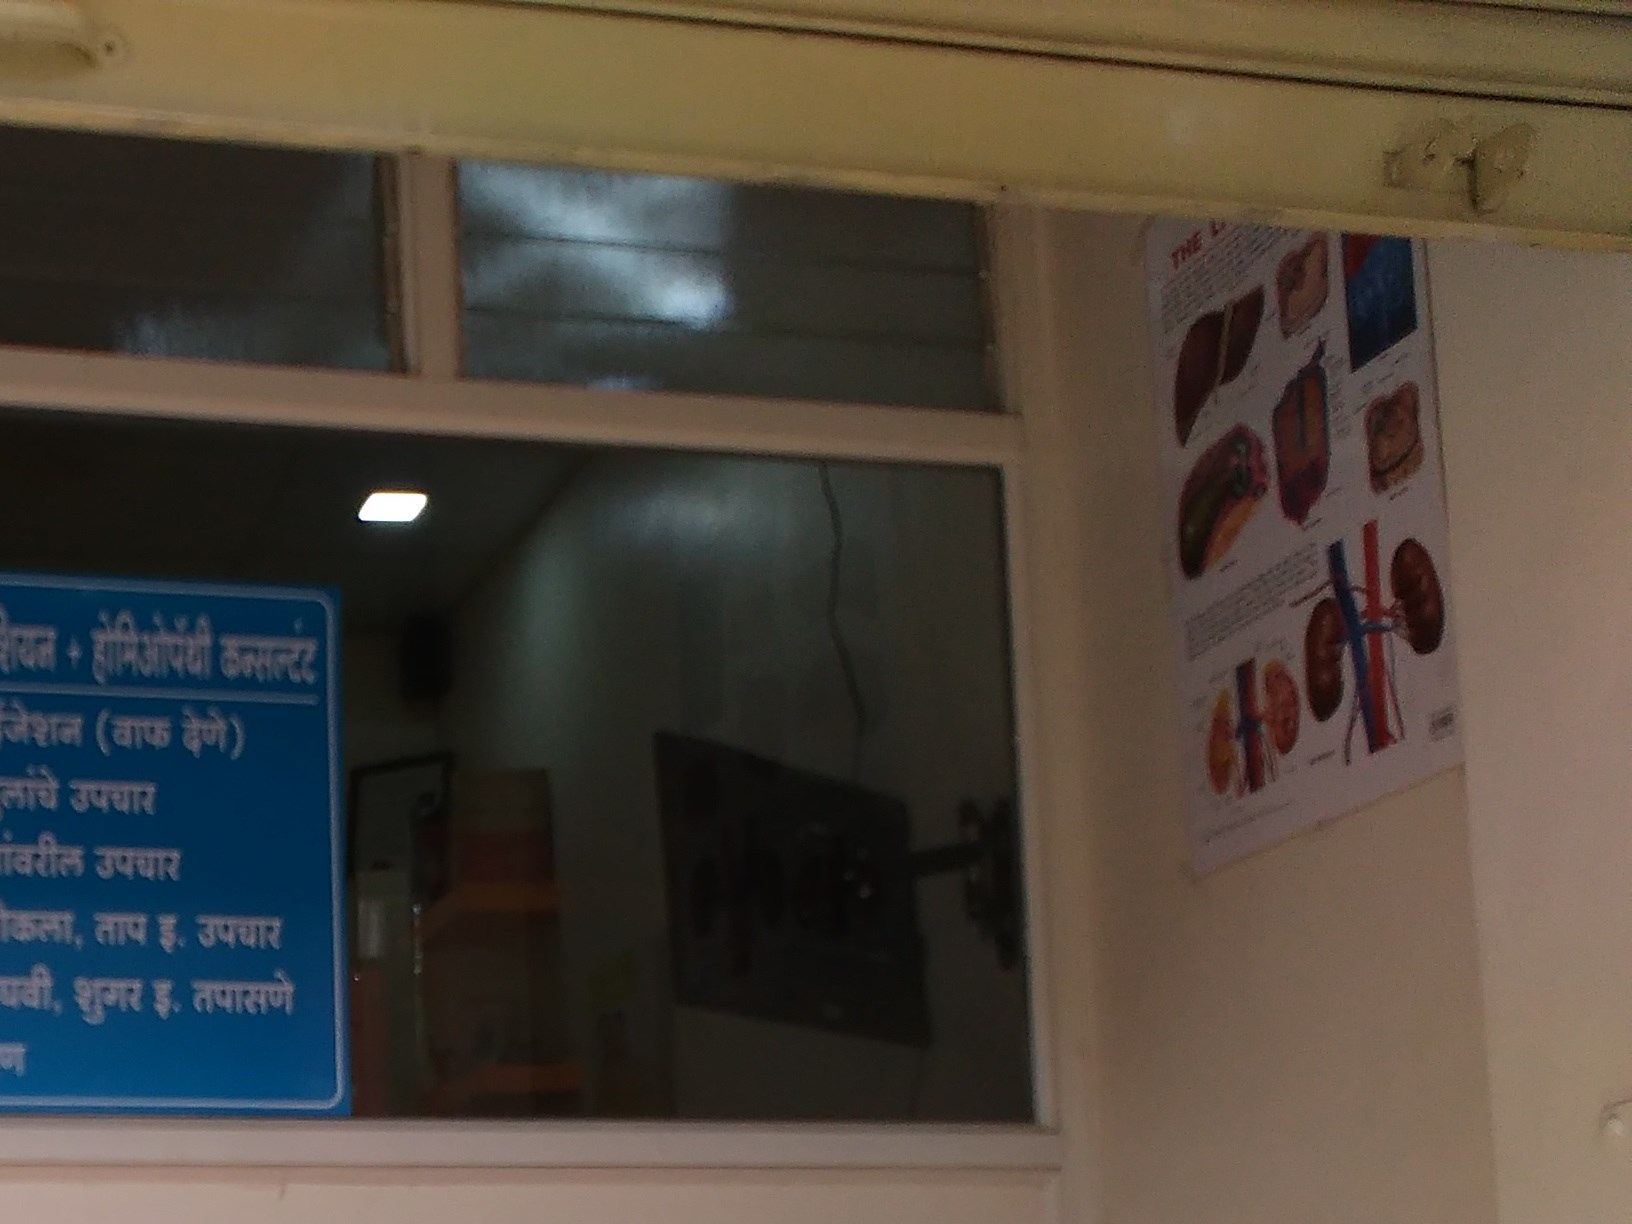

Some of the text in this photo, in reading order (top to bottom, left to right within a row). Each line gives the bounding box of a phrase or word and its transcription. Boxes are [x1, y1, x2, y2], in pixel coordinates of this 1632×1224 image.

[70, 780, 156, 814] उपचार
[95, 847, 181, 880] उपचार
[95, 913, 147, 944] ताप
[197, 915, 282, 948] उपचार
